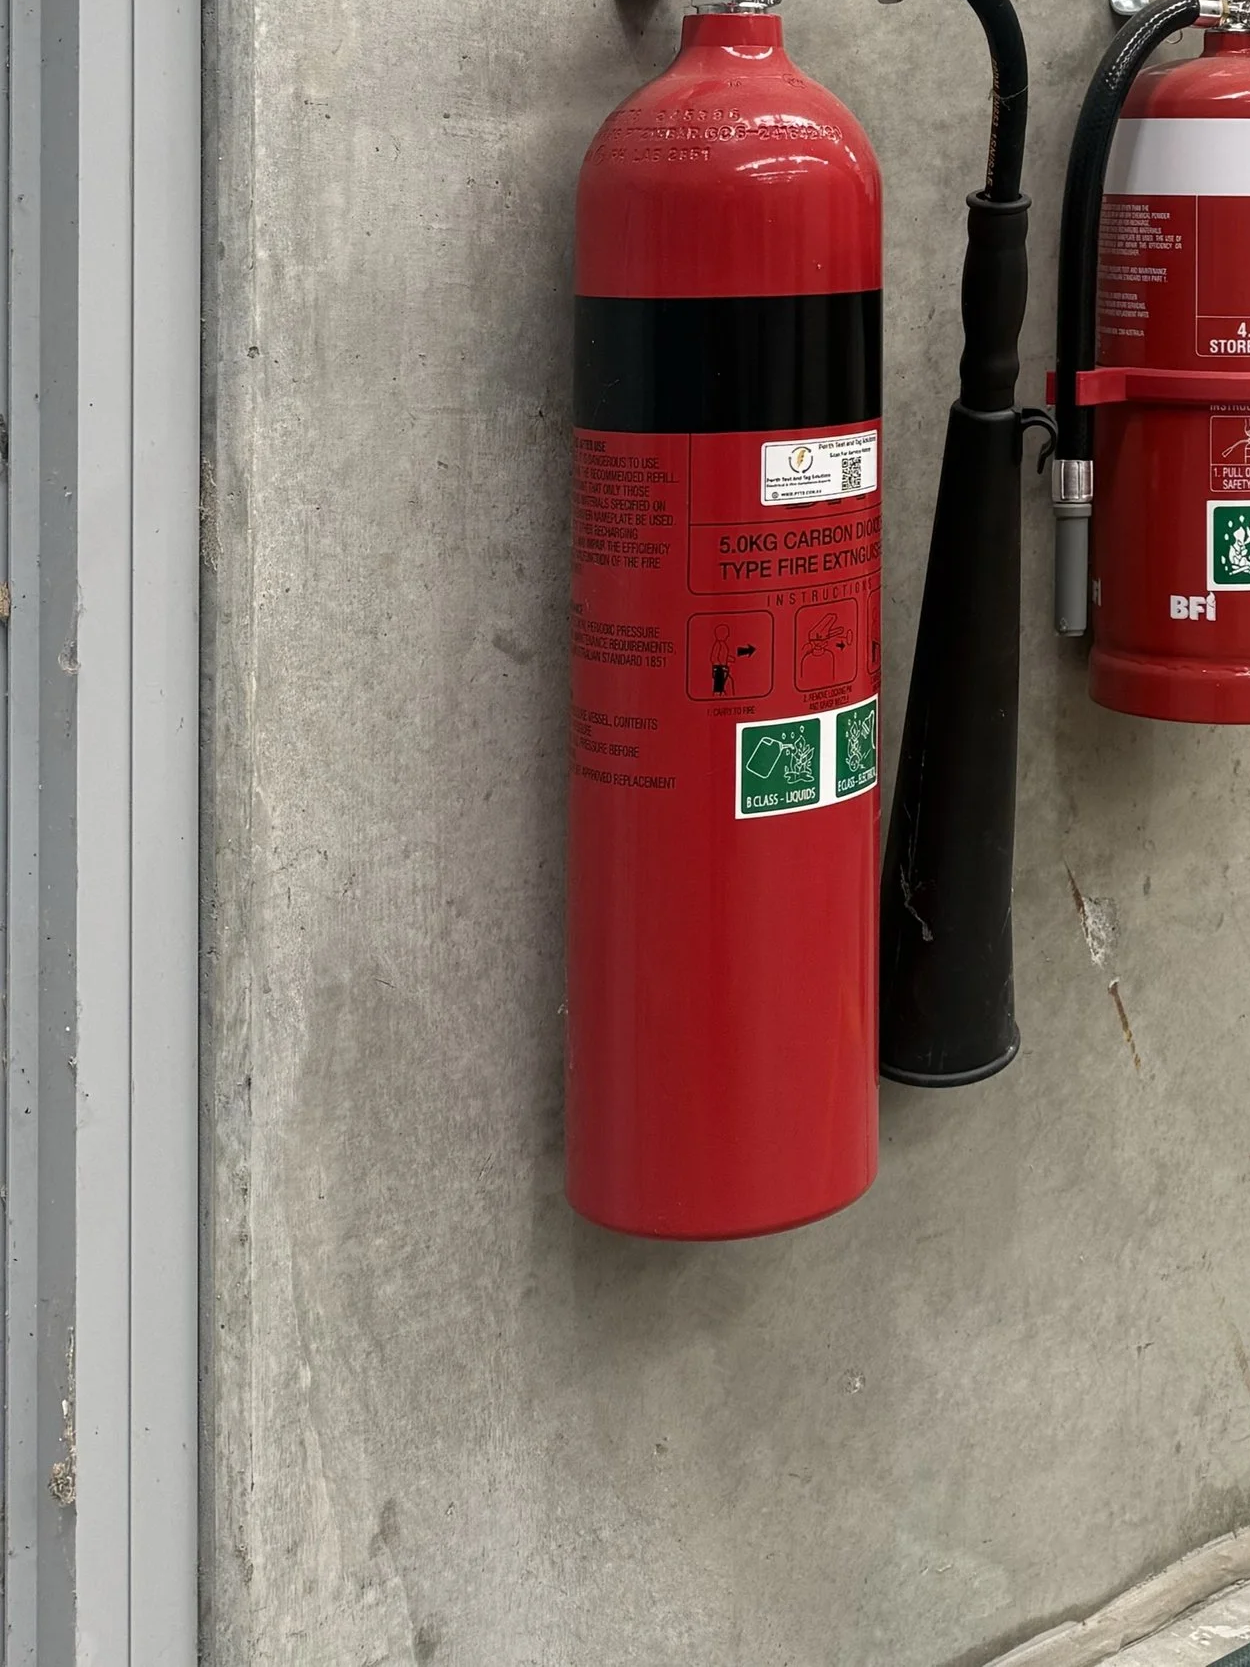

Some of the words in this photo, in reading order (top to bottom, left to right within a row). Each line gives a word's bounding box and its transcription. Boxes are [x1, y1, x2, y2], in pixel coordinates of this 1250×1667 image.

[627, 457, 640, 468] TO
[642, 457, 659, 469] USE
[591, 468, 644, 482] RECOMMENDED
[1213, 468, 1221, 478] 1.
[1222, 467, 1243, 478] PULL
[603, 483, 621, 495] ONLY
[623, 484, 650, 497] THOSE
[610, 498, 650, 511] SPECIFIED
[653, 500, 666, 512] ON
[594, 511, 632, 525] NAMEPLATE
[635, 514, 647, 525] BE
[593, 525, 638, 540] RECHARGING
[719, 533, 777, 554] 5.0KG
[783, 524, 853, 550] CARBON
[607, 540, 621, 553] THE
[622, 542, 671, 555] EFFICIENCY
[611, 555, 621, 567] OF
[624, 556, 639, 568] THE
[641, 557, 661, 569] FIRE
[719, 560, 771, 580] TYPE
[778, 555, 819, 576] FIRE
[767, 578, 873, 607] INSTRUCTIONS
[617, 625, 660, 639] PRESSURE
[602, 652, 642, 666] STANDARD
[644, 656, 667, 668] 1851
[808, 691, 827, 702] REMOVE
[713, 707, 733, 717] CARRY
[734, 707, 742, 715] TO
[743, 705, 755, 715] FIRE
[613, 716, 658, 731] CONTENTS
[608, 743, 640, 758] BEFORE
[613, 773, 676, 789] REPLACEMENT
[837, 781, 842, 792] E
[746, 797, 751, 809] B
[753, 792, 778, 808] CLASS
[785, 787, 816, 804] LIQUIDS
